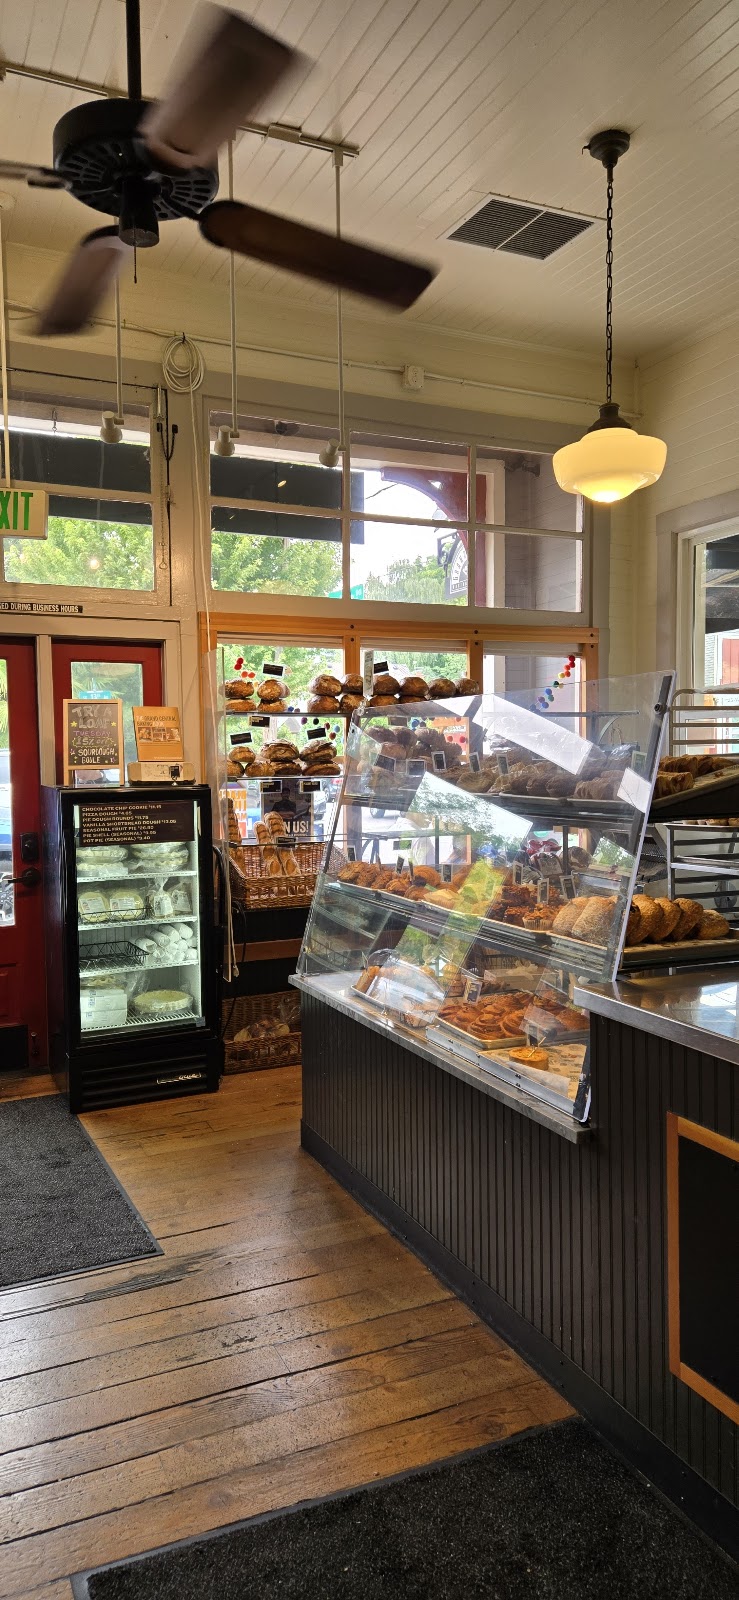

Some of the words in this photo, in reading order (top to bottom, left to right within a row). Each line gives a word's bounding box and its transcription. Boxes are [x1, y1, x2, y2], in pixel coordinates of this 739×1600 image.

[0, 491, 33, 530] XIT
[10, 602, 31, 611] DURING
[33, 603, 59, 612] BUSINESS
[60, 605, 79, 613] HOURS
[72, 705, 100, 717] TRY
[103, 706, 112, 717] A
[78, 717, 110, 729] LOAF
[78, 747, 115, 756] SOURDOUGH
[293, 820, 309, 833] US!
